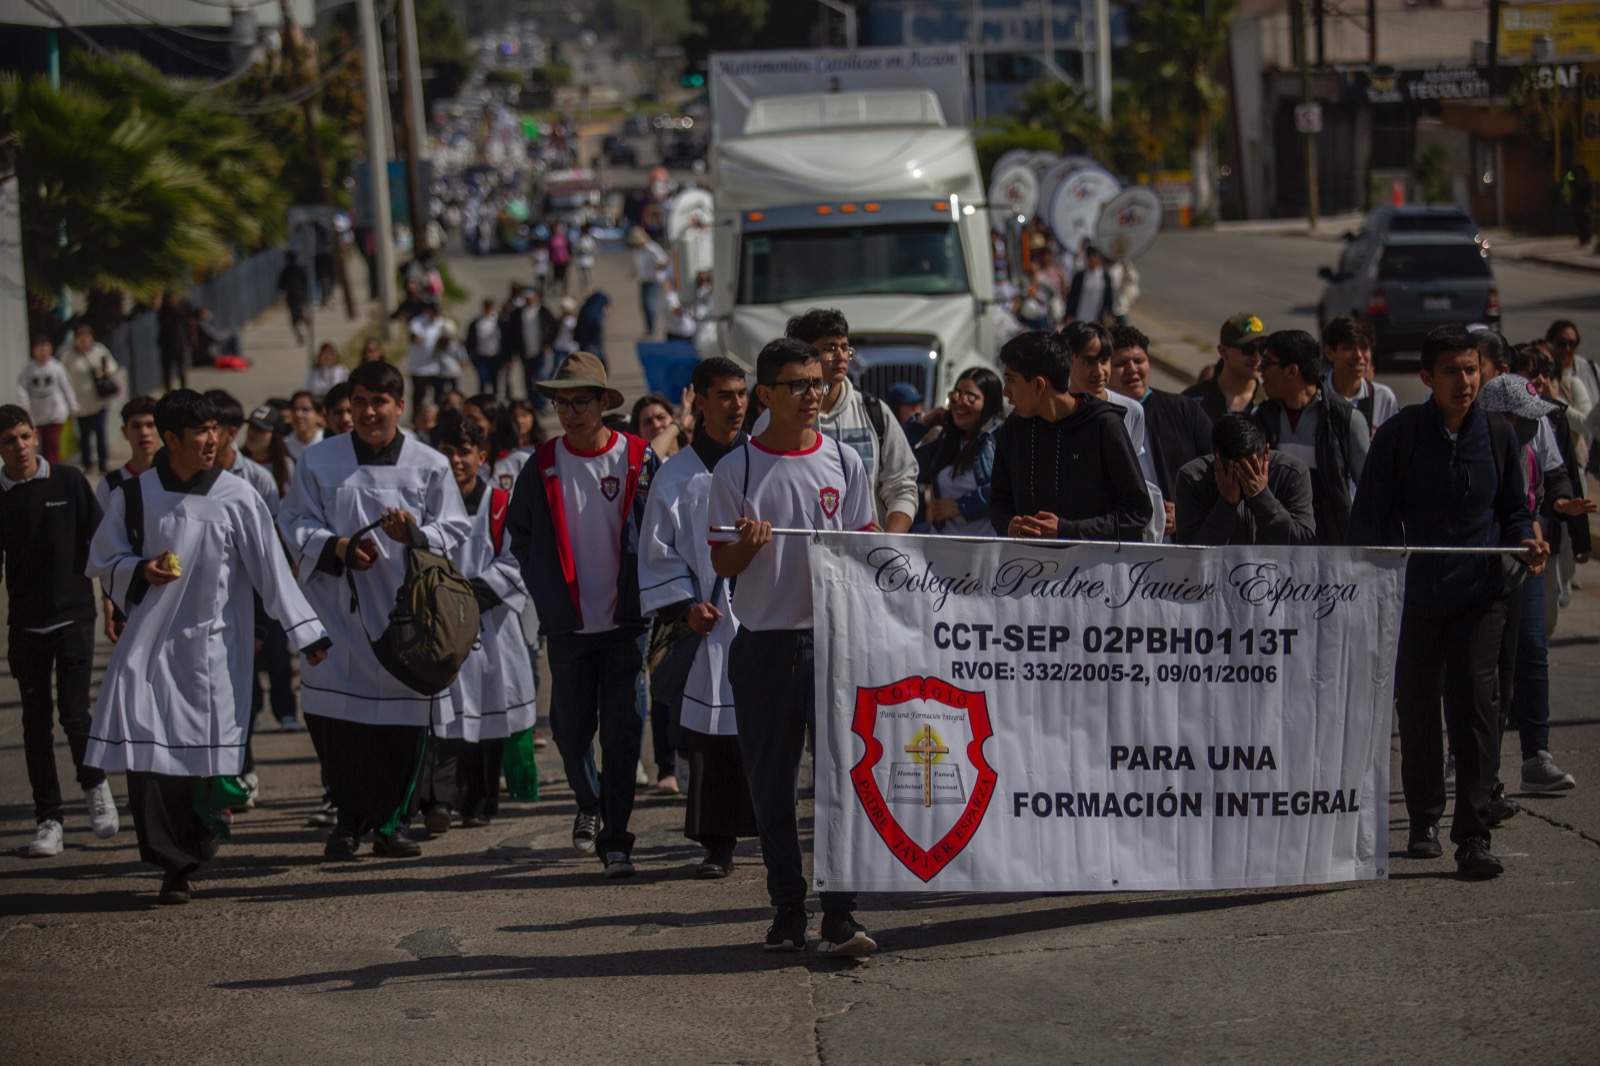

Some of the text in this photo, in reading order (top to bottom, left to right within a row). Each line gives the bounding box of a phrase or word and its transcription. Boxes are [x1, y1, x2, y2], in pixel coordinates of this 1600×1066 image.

[866, 547, 1360, 620] Colegio Padre Javier Esparza
[933, 621, 1299, 655] CCT-SEP 02PBH0113T
[951, 661, 1278, 686] RVOE: 332/2005-2, 09/01/2006
[874, 684, 967, 706] COLEGIO
[879, 710, 896, 718] Para
[942, 712, 966, 724] Integral
[1110, 745, 1277, 771] PARA UNA
[934, 770, 955, 778] Pastoral
[1013, 786, 1360, 818] FORMACIÓN INTEGRAL
[858, 778, 991, 869] PADRE JAVIER ESPARZA
